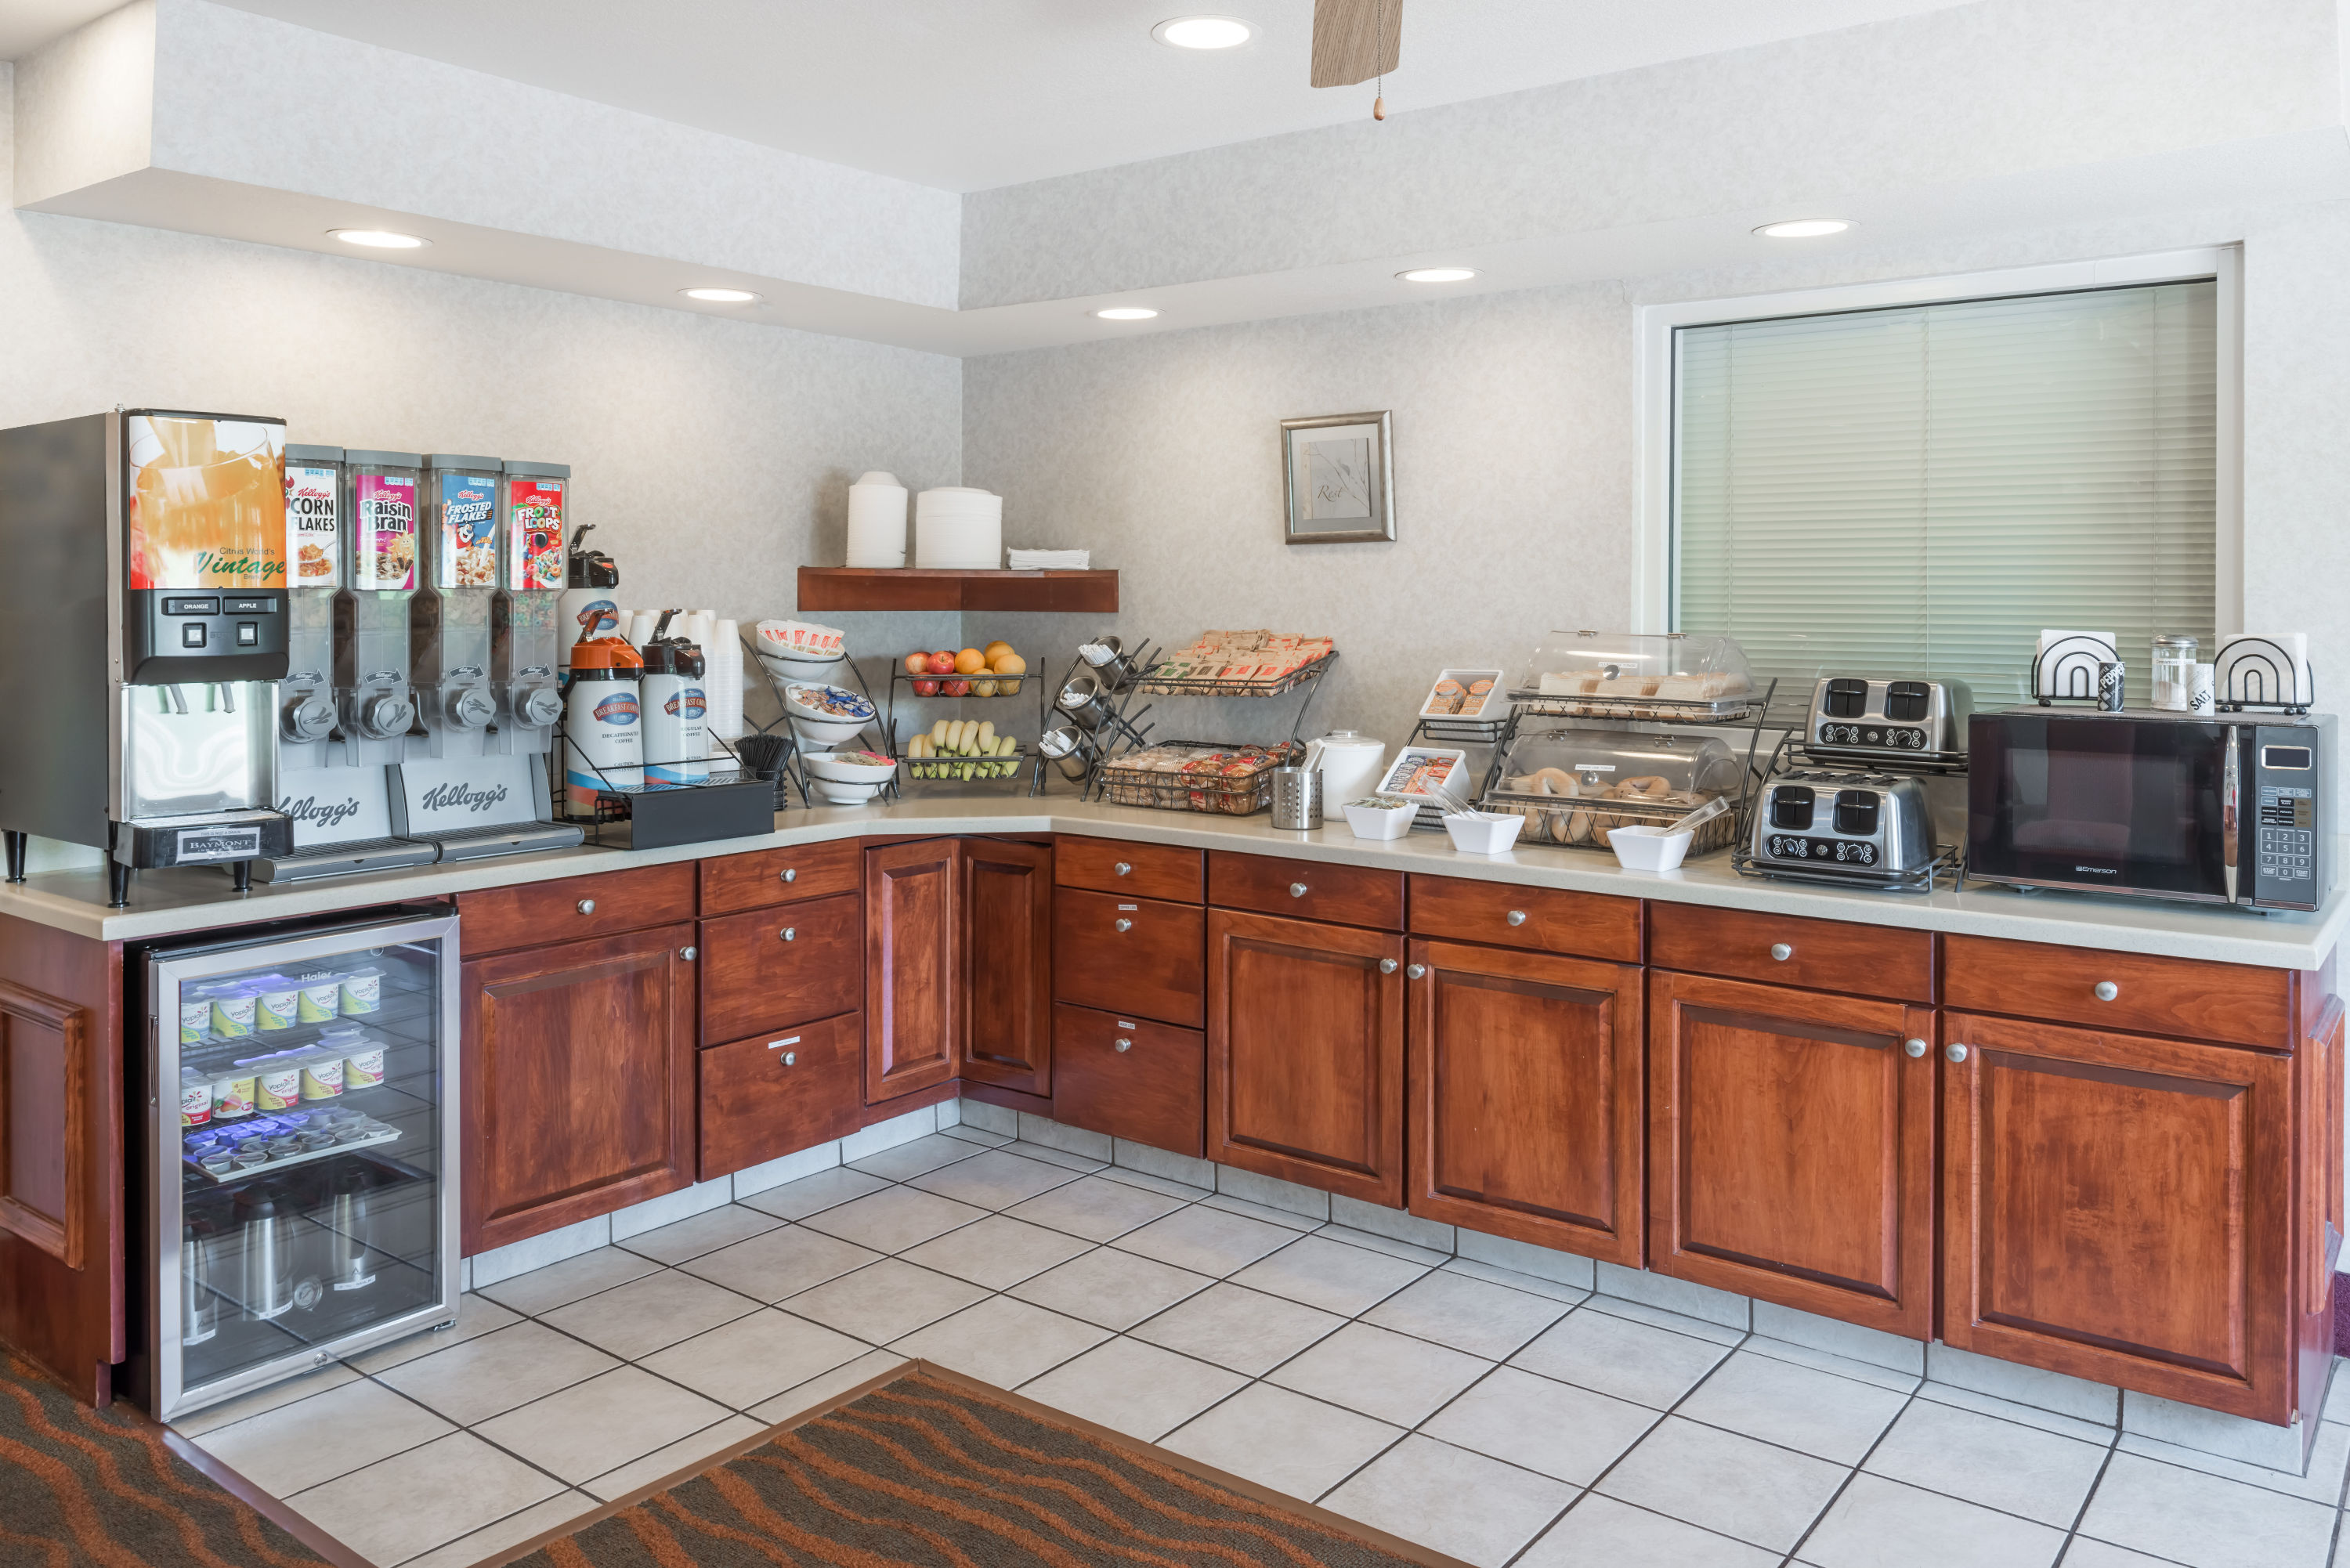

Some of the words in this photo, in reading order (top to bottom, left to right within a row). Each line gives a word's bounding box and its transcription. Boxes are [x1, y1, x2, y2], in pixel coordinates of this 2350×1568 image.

[298, 487, 331, 500] Kellogg's
[374, 490, 401, 500] Kellogg's
[458, 490, 484, 500] Kellogg's
[527, 495, 551, 505] Kellogg's
[1318, 485, 1343, 502] Rest
[291, 497, 334, 515] CORN
[361, 500, 412, 519] Raisin
[447, 501, 492, 515] FROSTED
[447, 511, 487, 524] FLAKES
[518, 506, 557, 521] FROOT
[367, 516, 407, 531] Bran
[524, 517, 559, 530] LOOPS
[197, 551, 285, 581] Vintage
[2099, 663, 2124, 689] PEPPER
[665, 698, 696, 712] BREAFAST
[2189, 690, 2211, 710] SALT
[595, 704, 626, 717] BREAKFAST
[422, 782, 508, 812] Kellogg's
[190, 840, 250, 849] BAYMONT
[186, 1100, 208, 1111] original
